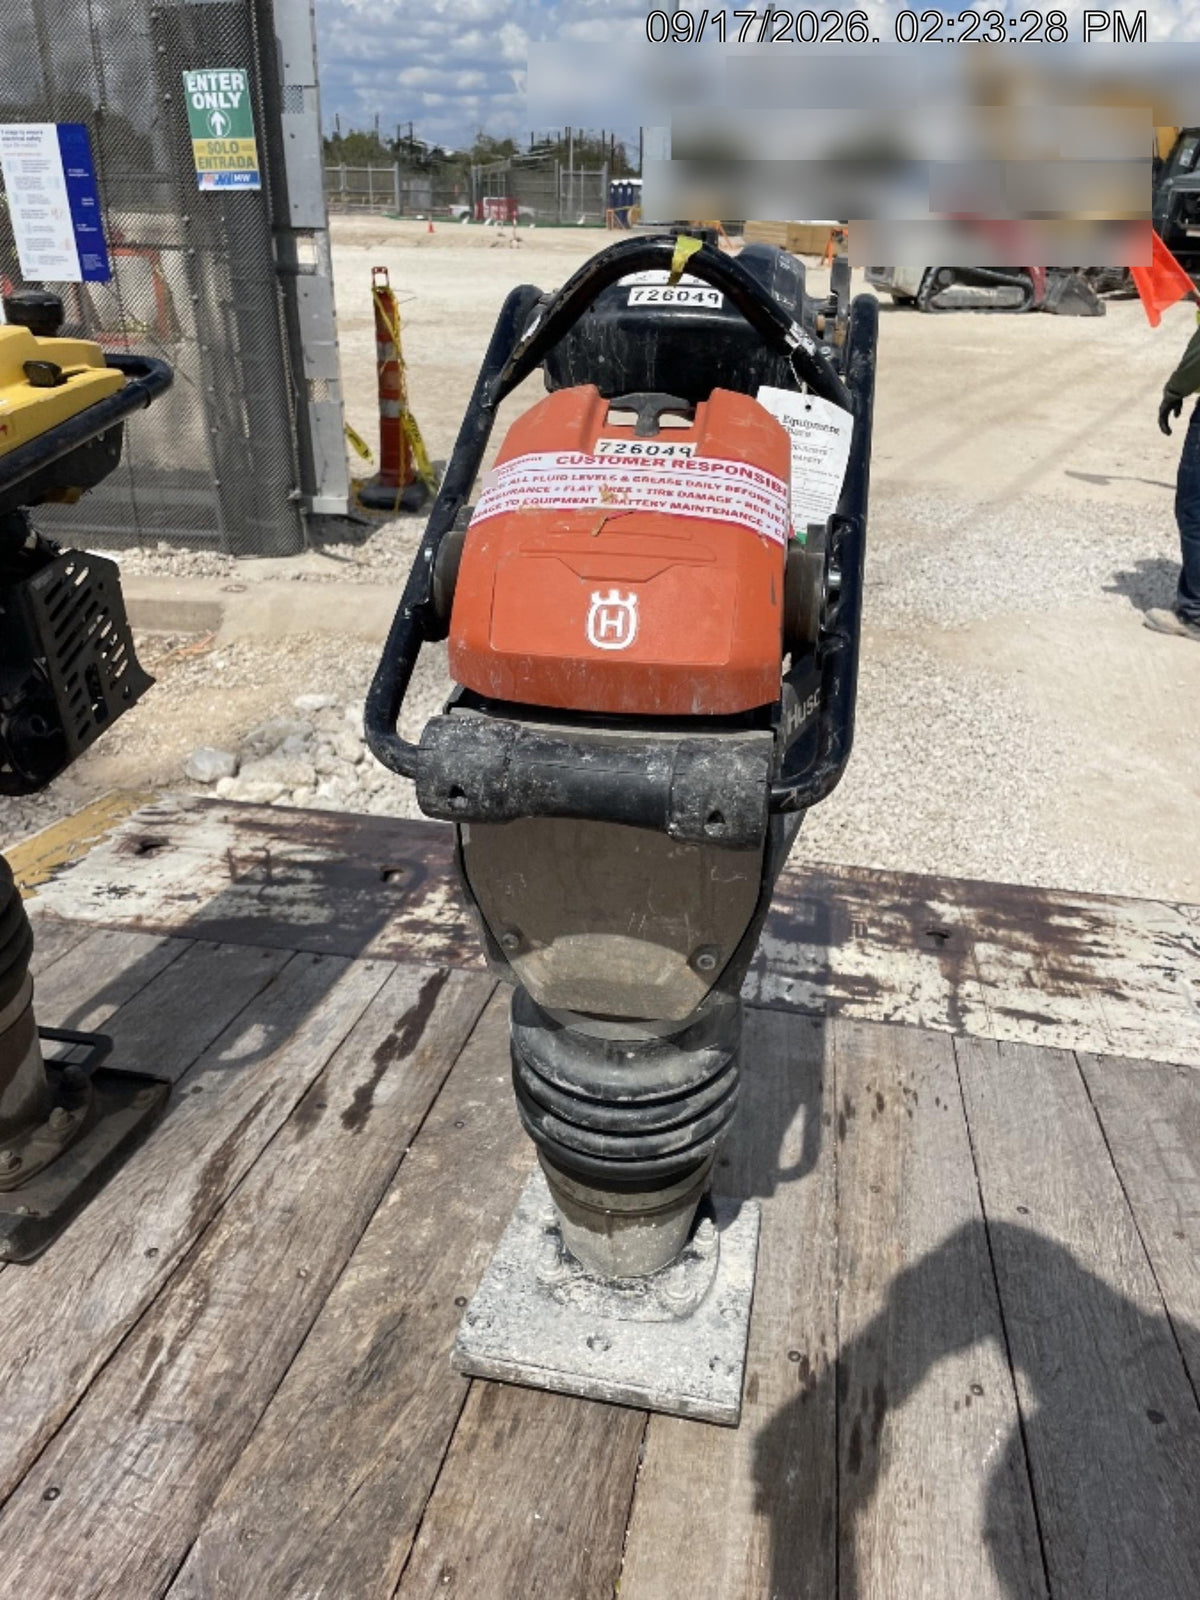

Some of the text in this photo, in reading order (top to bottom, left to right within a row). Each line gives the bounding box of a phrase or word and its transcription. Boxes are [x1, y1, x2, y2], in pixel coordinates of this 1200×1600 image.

[187, 72, 245, 93] ENTER
[191, 92, 242, 110] ONLY
[207, 141, 239, 155] SOLO
[198, 156, 256, 170] ENTRADA
[634, 289, 719, 304] 726049
[600, 442, 691, 458] 726049
[556, 456, 665, 467] CUSTOMER
[508, 475, 529, 485] ALL
[532, 474, 569, 484] FLUID
[571, 474, 618, 482] LEVELS
[633, 475, 682, 486] GREASE
[685, 479, 721, 490] DAILY
[725, 484, 771, 505] BEFORE
[647, 488, 674, 496] TIRE
[677, 491, 732, 504] DAMAGE
[522, 497, 598, 505] EQUIPMENT
[669, 502, 763, 527] MAINTENANCE
